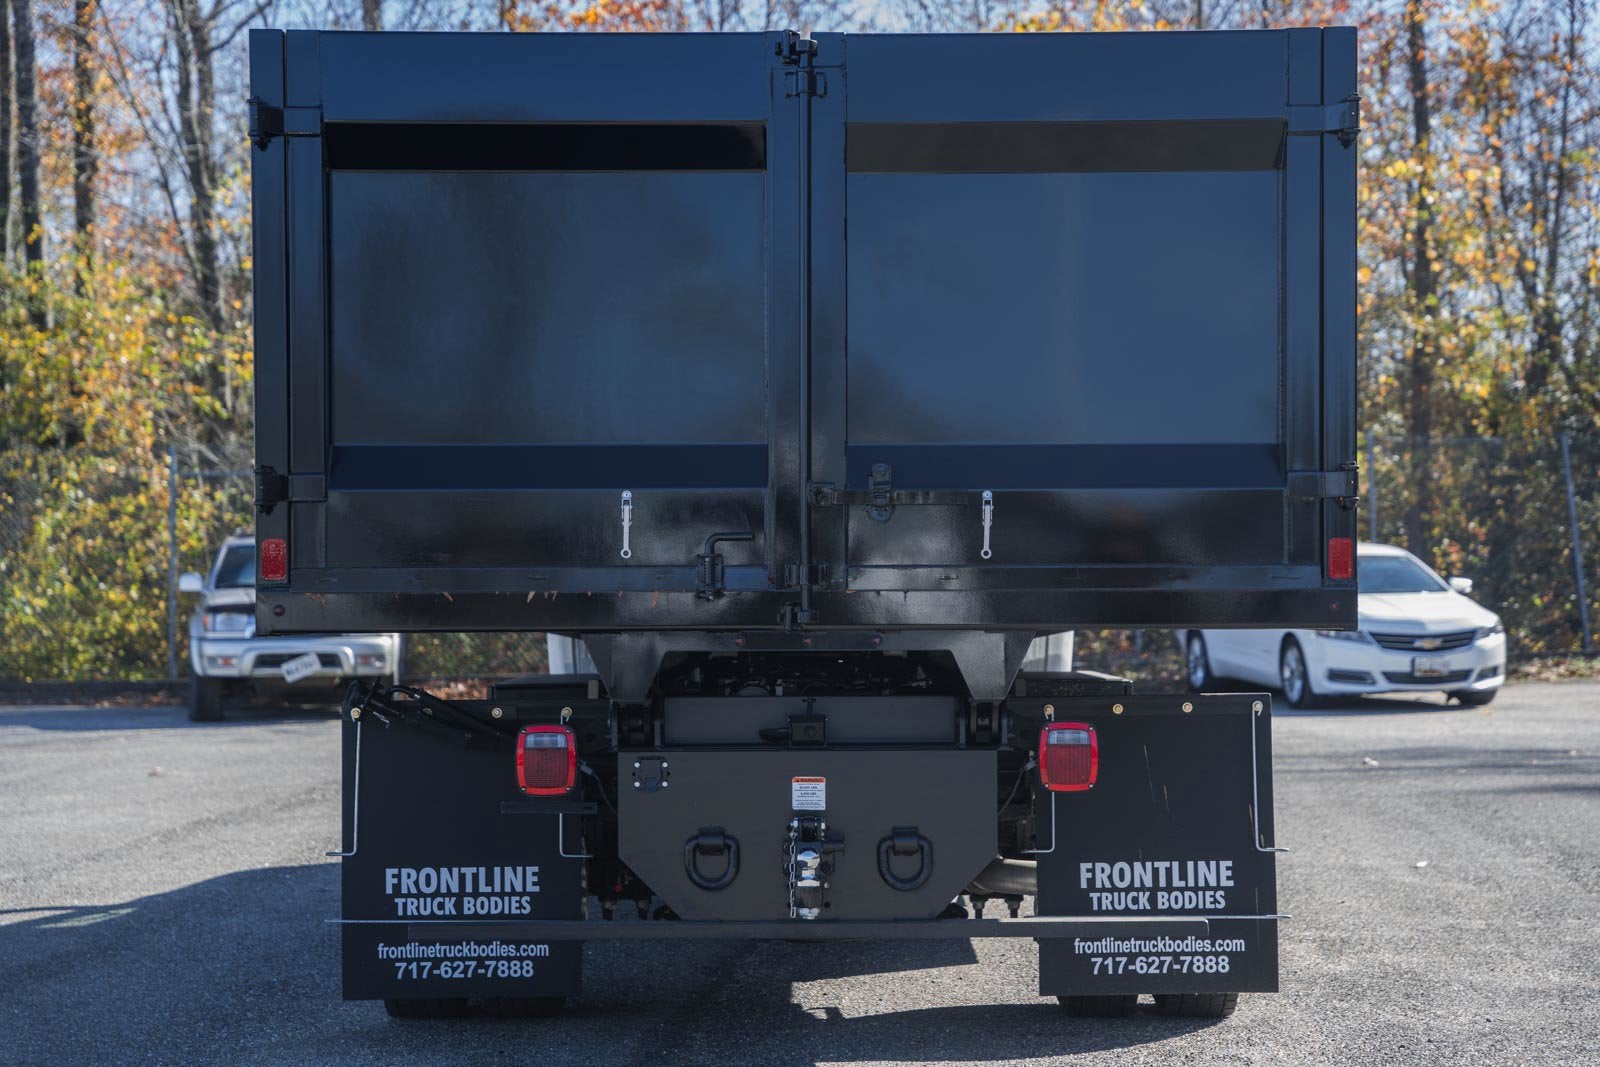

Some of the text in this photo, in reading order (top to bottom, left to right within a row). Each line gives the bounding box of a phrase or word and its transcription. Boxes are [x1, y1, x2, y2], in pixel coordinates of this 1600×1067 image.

[385, 866, 540, 894] FRONTLINE
[1079, 860, 1235, 889] FRONTLINE
[394, 896, 531, 916] TRUCK BODIES
[1089, 890, 1226, 911] TRUCK BODIES
[377, 941, 549, 959] frontlinetruckbodies.com
[1073, 936, 1246, 954] frontlinetruckbodies.com
[394, 960, 534, 980] 717-627-7888
[1091, 955, 1231, 975] 717-627-7888
